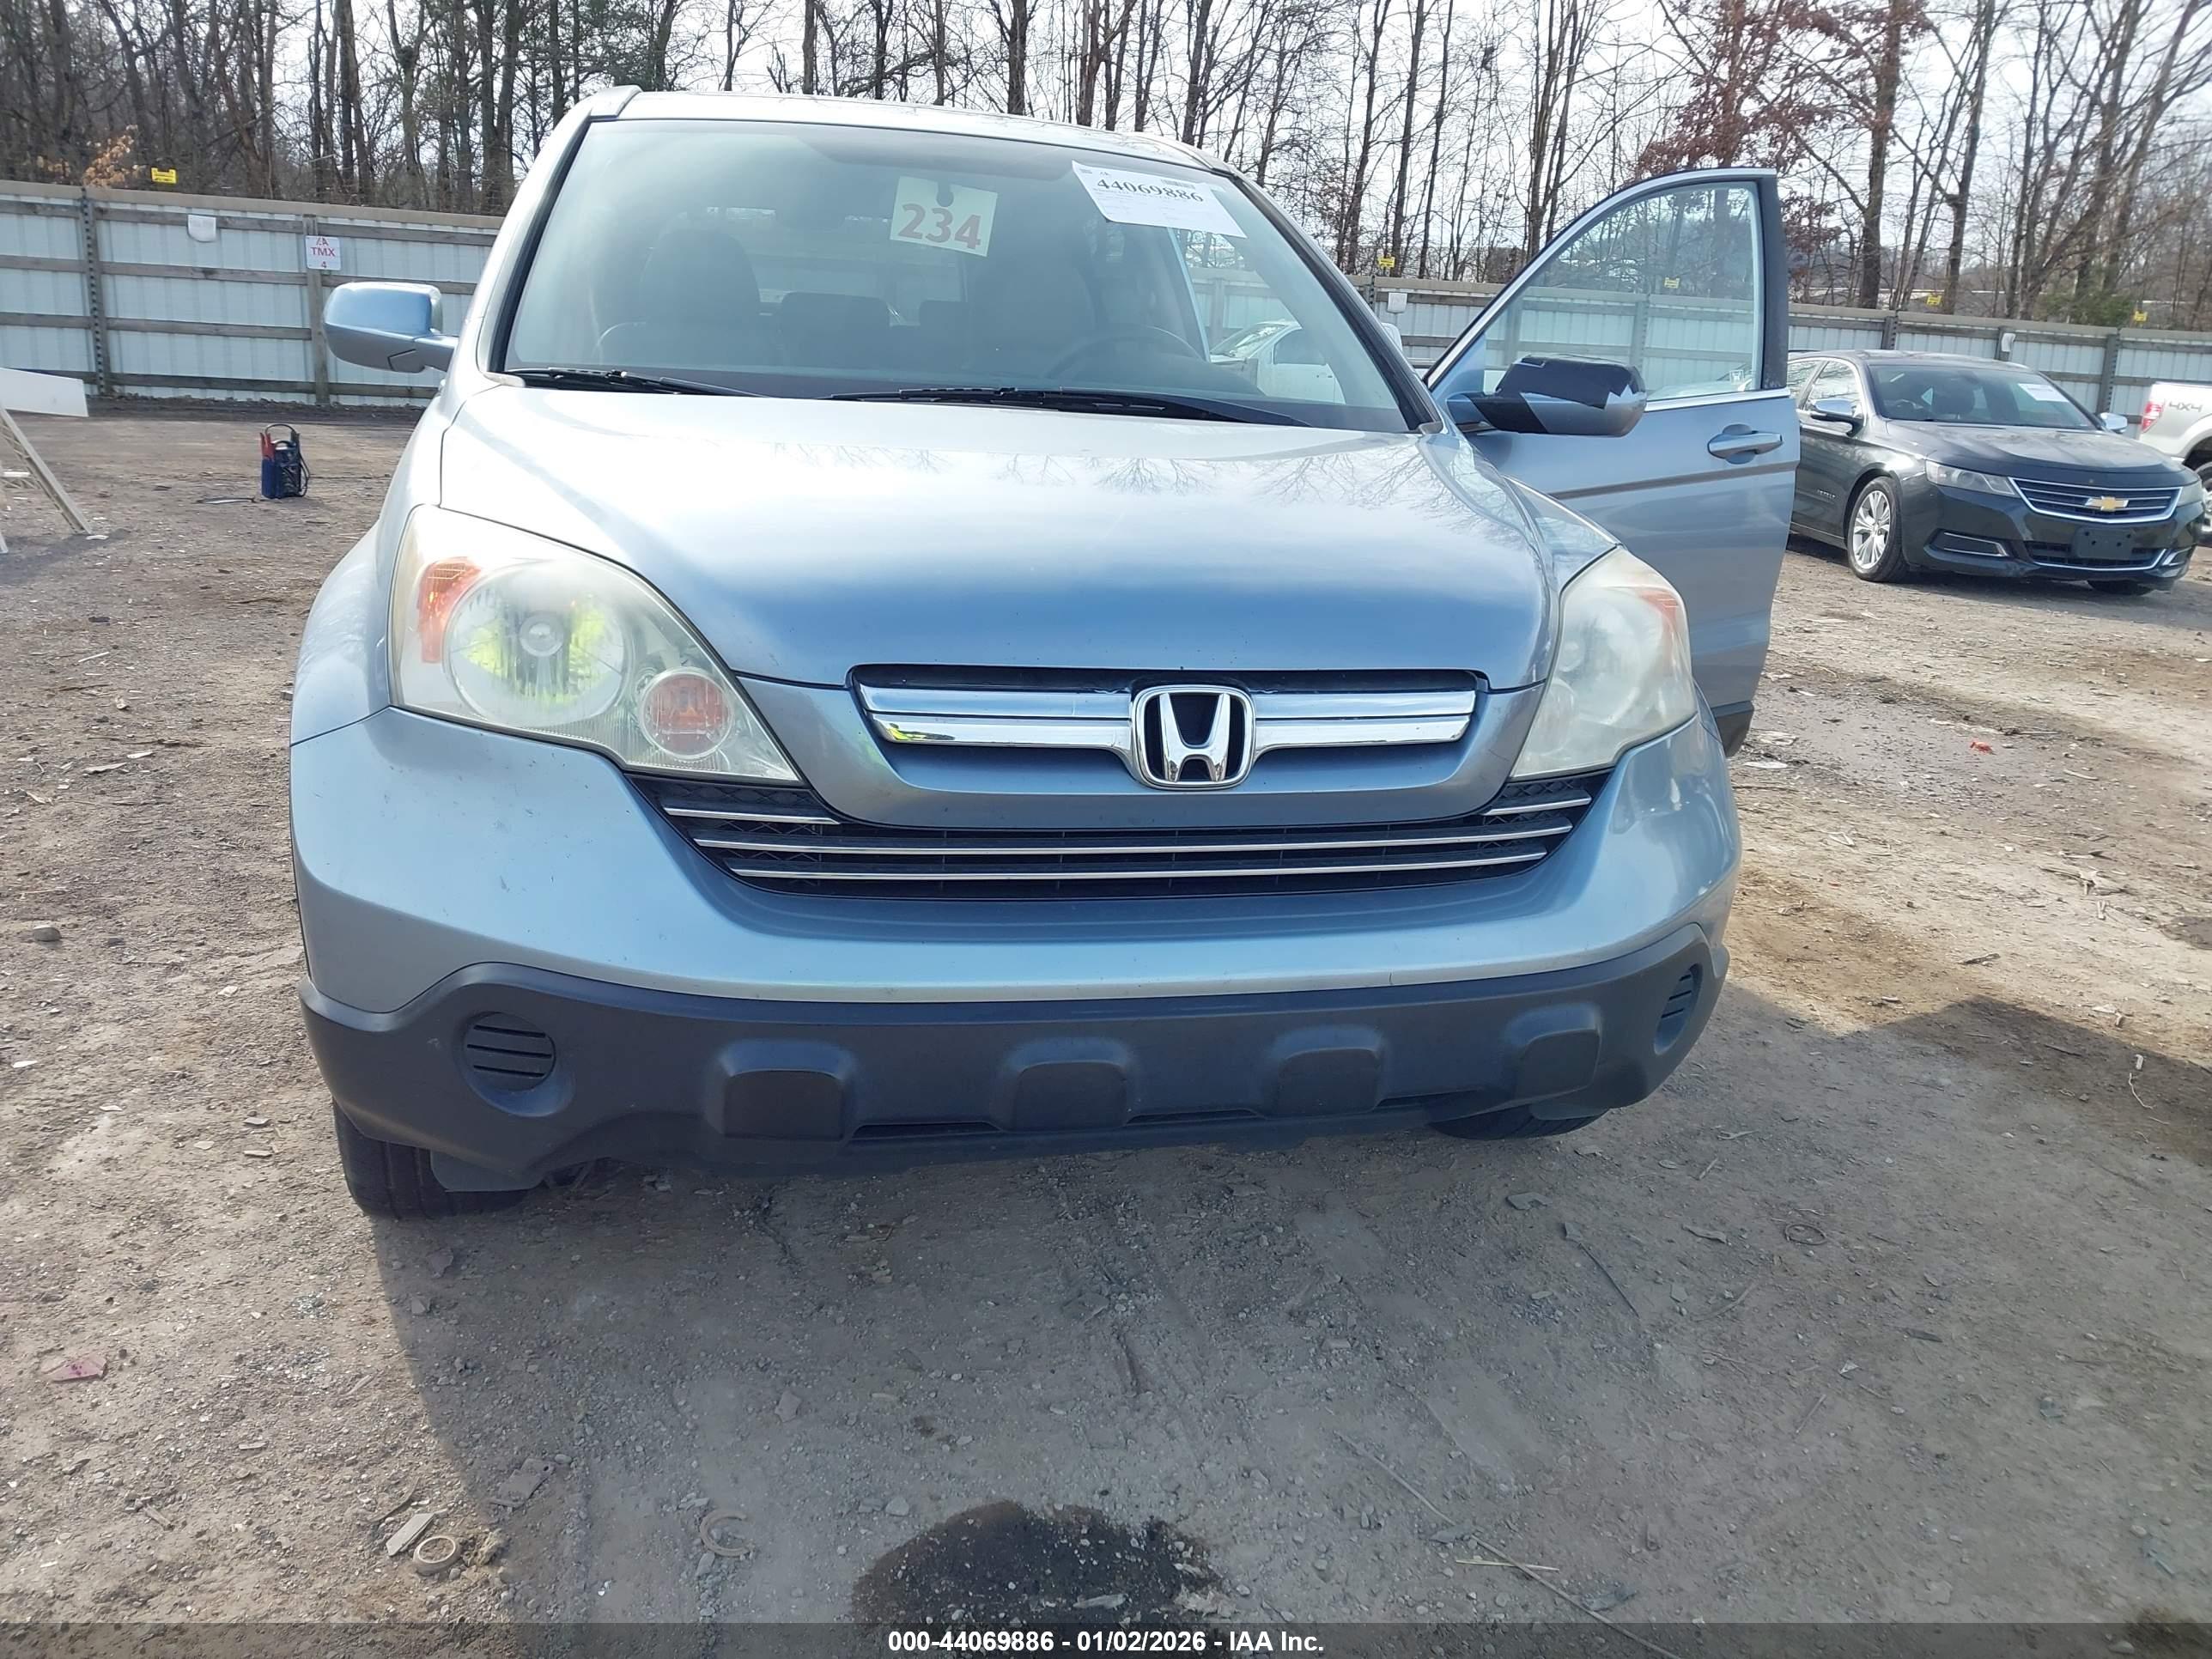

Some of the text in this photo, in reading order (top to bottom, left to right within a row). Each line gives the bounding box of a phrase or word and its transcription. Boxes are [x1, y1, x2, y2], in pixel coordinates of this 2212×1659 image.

[1097, 179, 1204, 202] 44069886
[898, 203, 981, 250] 234
[310, 246, 336, 257] TMX
